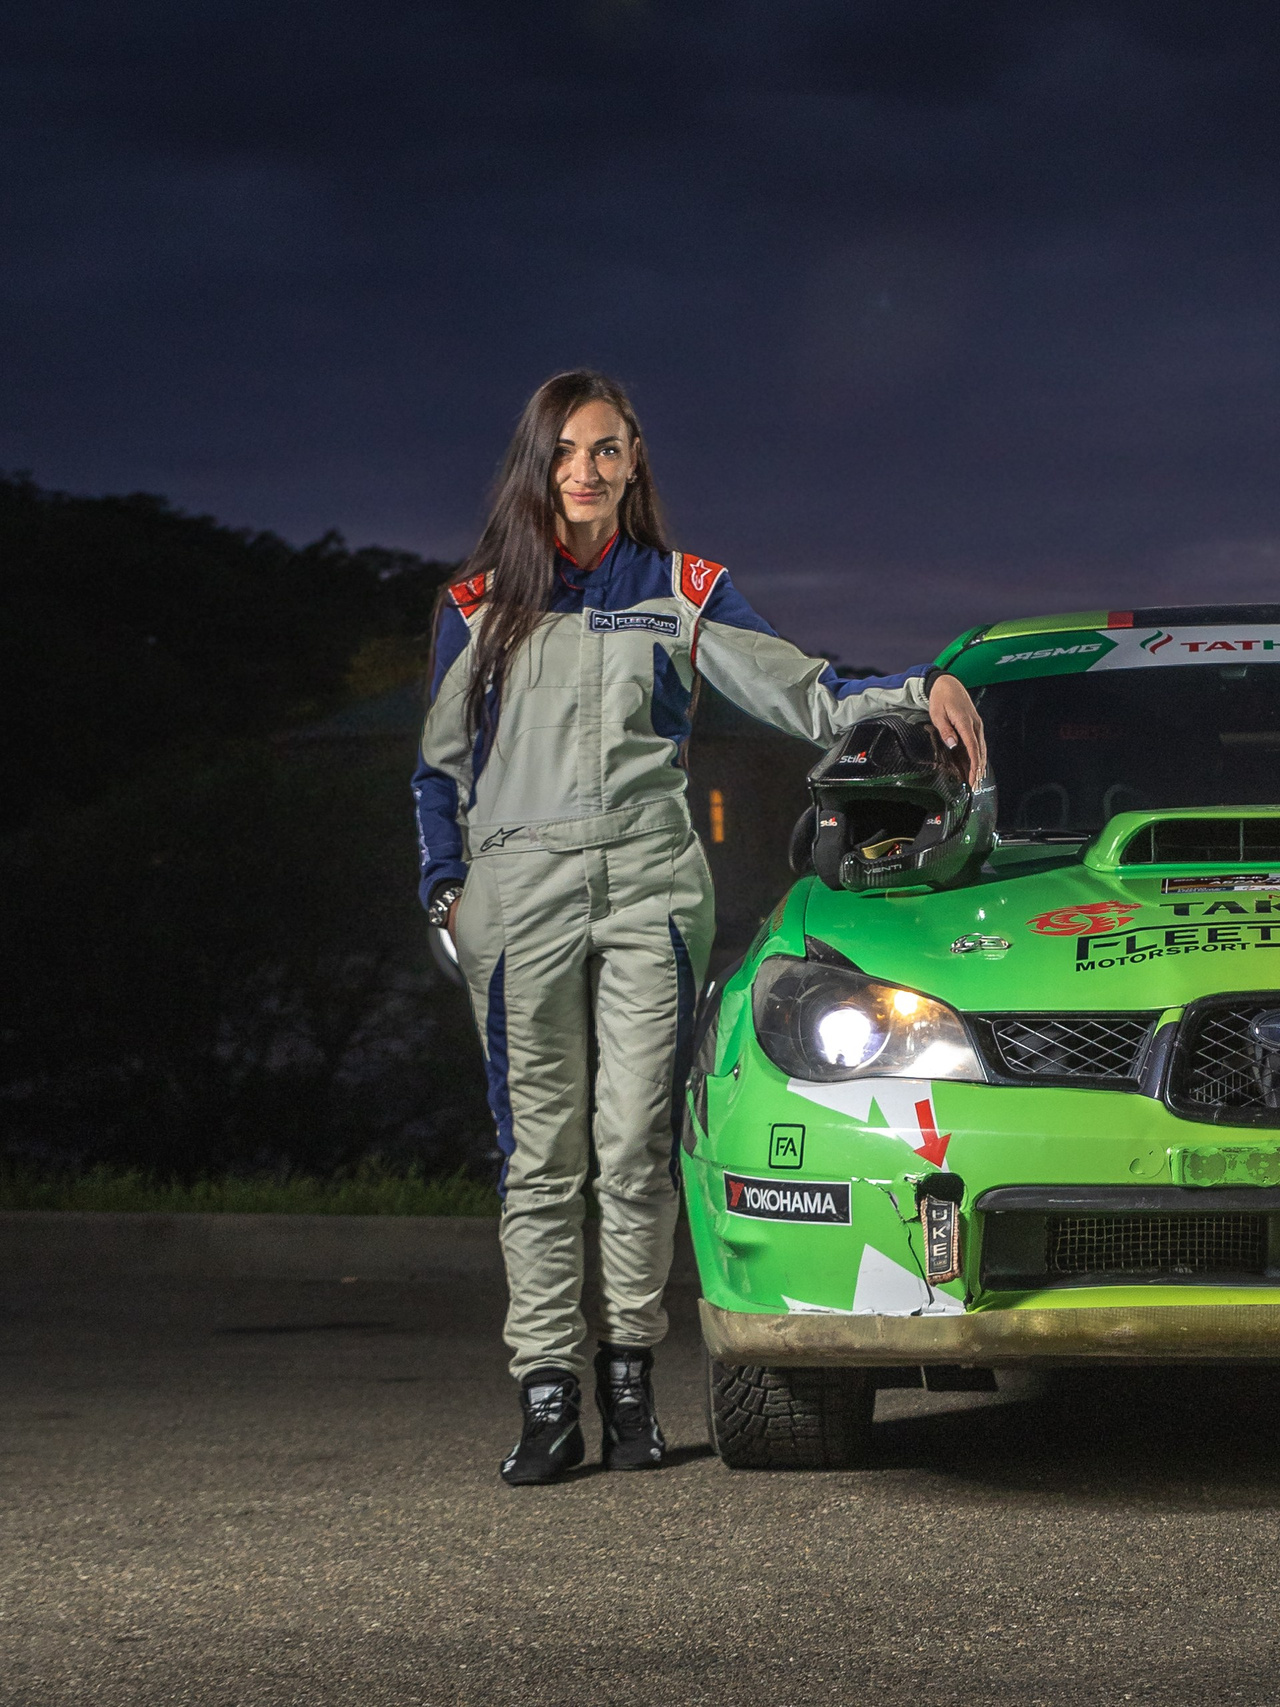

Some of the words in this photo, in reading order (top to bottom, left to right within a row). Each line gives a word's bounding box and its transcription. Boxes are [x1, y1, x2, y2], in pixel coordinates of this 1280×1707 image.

[595, 617, 611, 626] FA
[1076, 942, 1251, 972] MOTORSPORT
[776, 1137, 797, 1157] FA
[743, 1184, 837, 1216] YOKOHAMA
